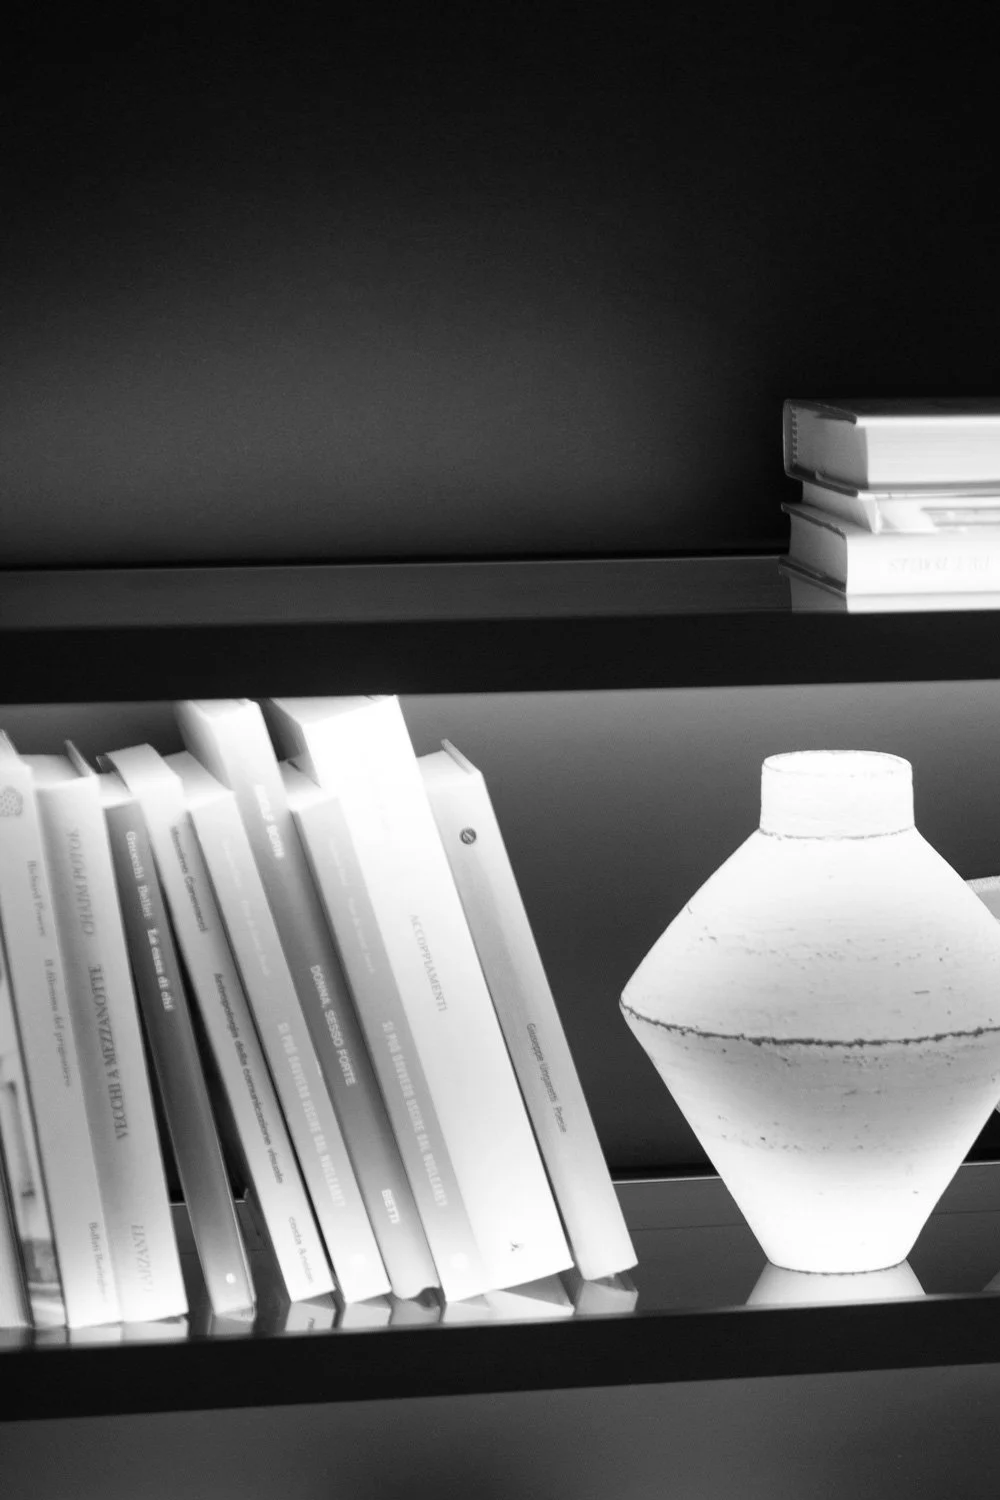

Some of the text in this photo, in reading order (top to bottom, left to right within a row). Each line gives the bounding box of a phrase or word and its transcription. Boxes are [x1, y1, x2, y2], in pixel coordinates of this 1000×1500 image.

[408, 912, 448, 1012] ACCOPPIAMENTI
[87, 963, 129, 1139] VECCHI A MEZZANOTTE
[323, 1008, 344, 1048] SESSO
[335, 1047, 357, 1086] FORTE
